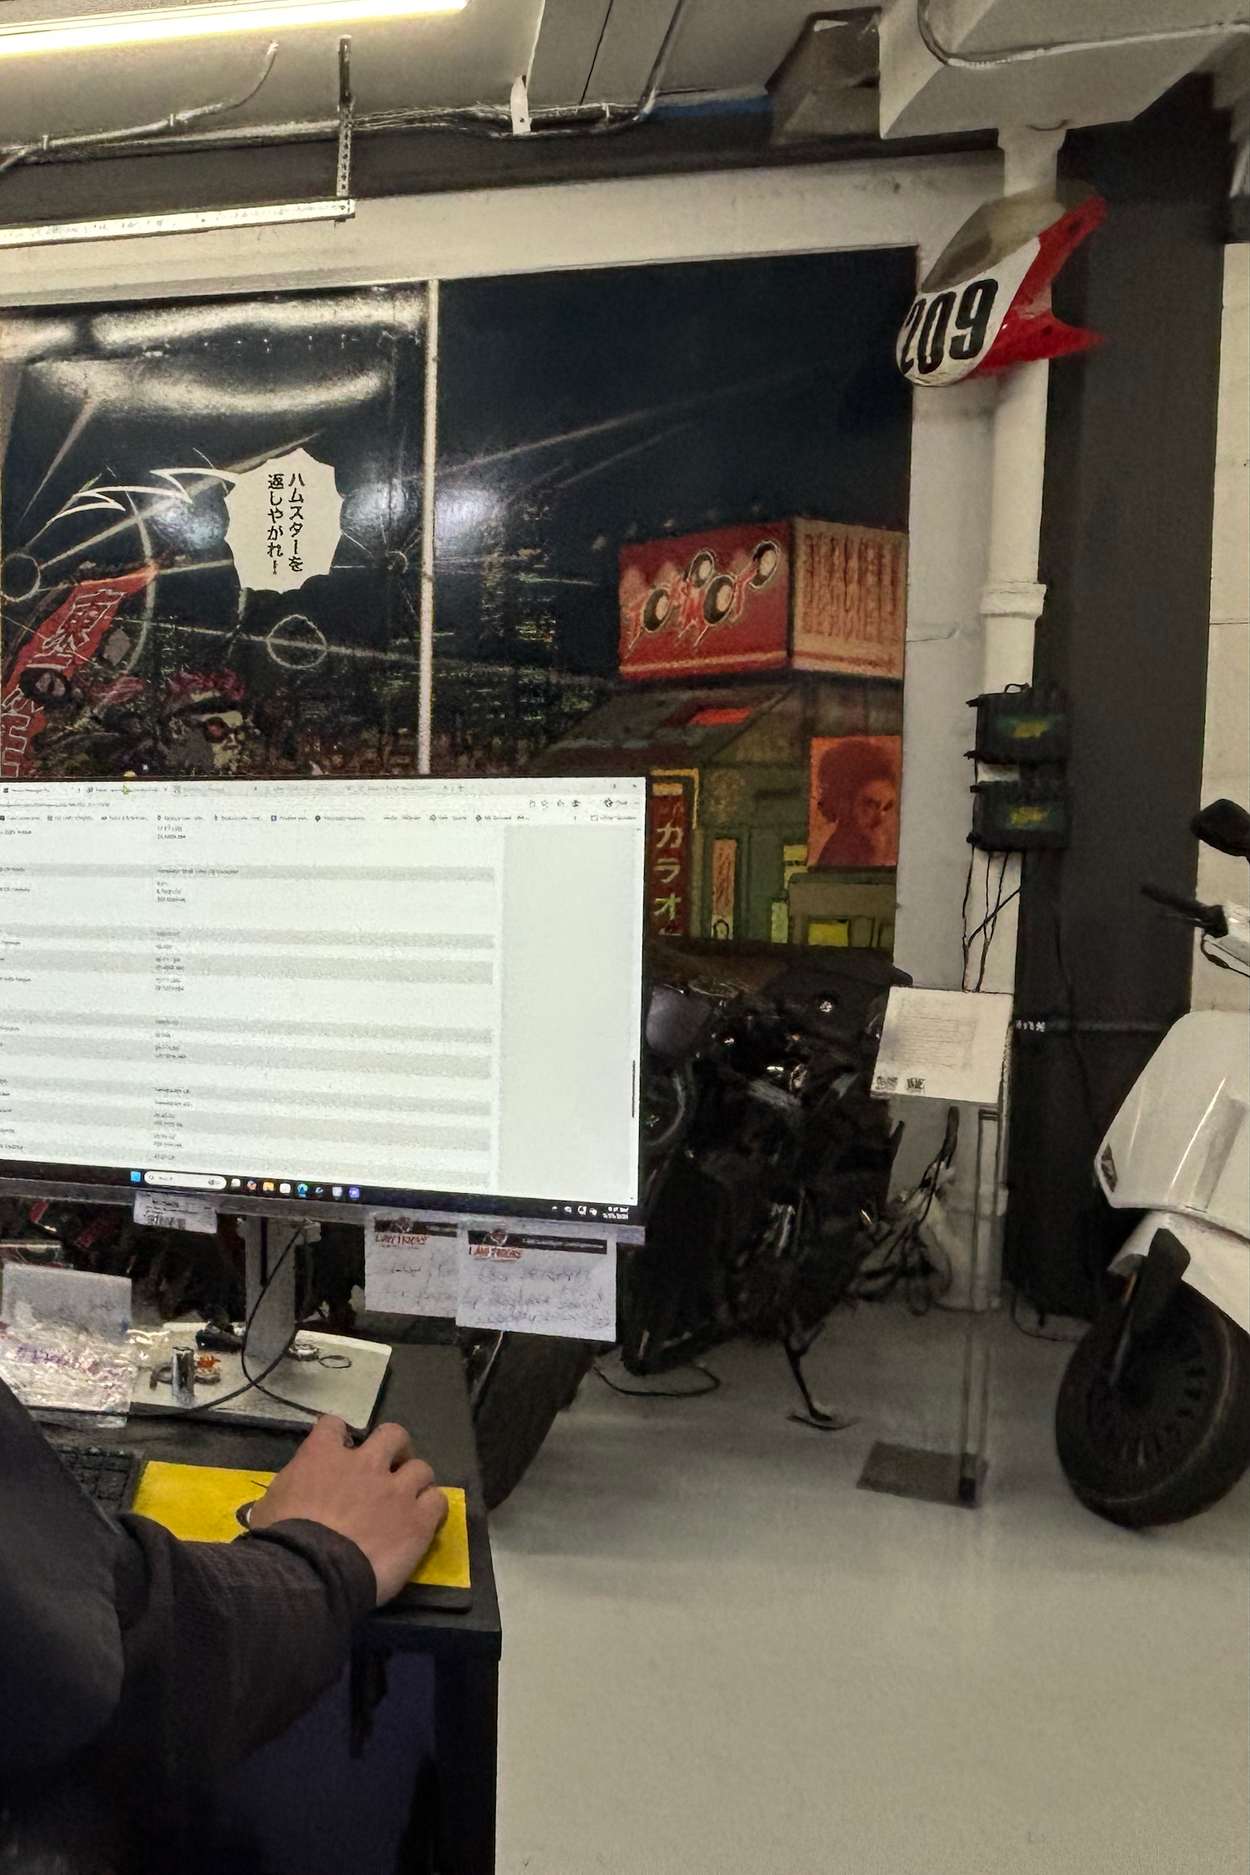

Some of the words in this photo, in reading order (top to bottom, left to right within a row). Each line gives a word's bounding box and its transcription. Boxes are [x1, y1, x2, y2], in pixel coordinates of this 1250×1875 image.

[900, 278, 999, 375] 209
[288, 472, 306, 573] ハムスターを
